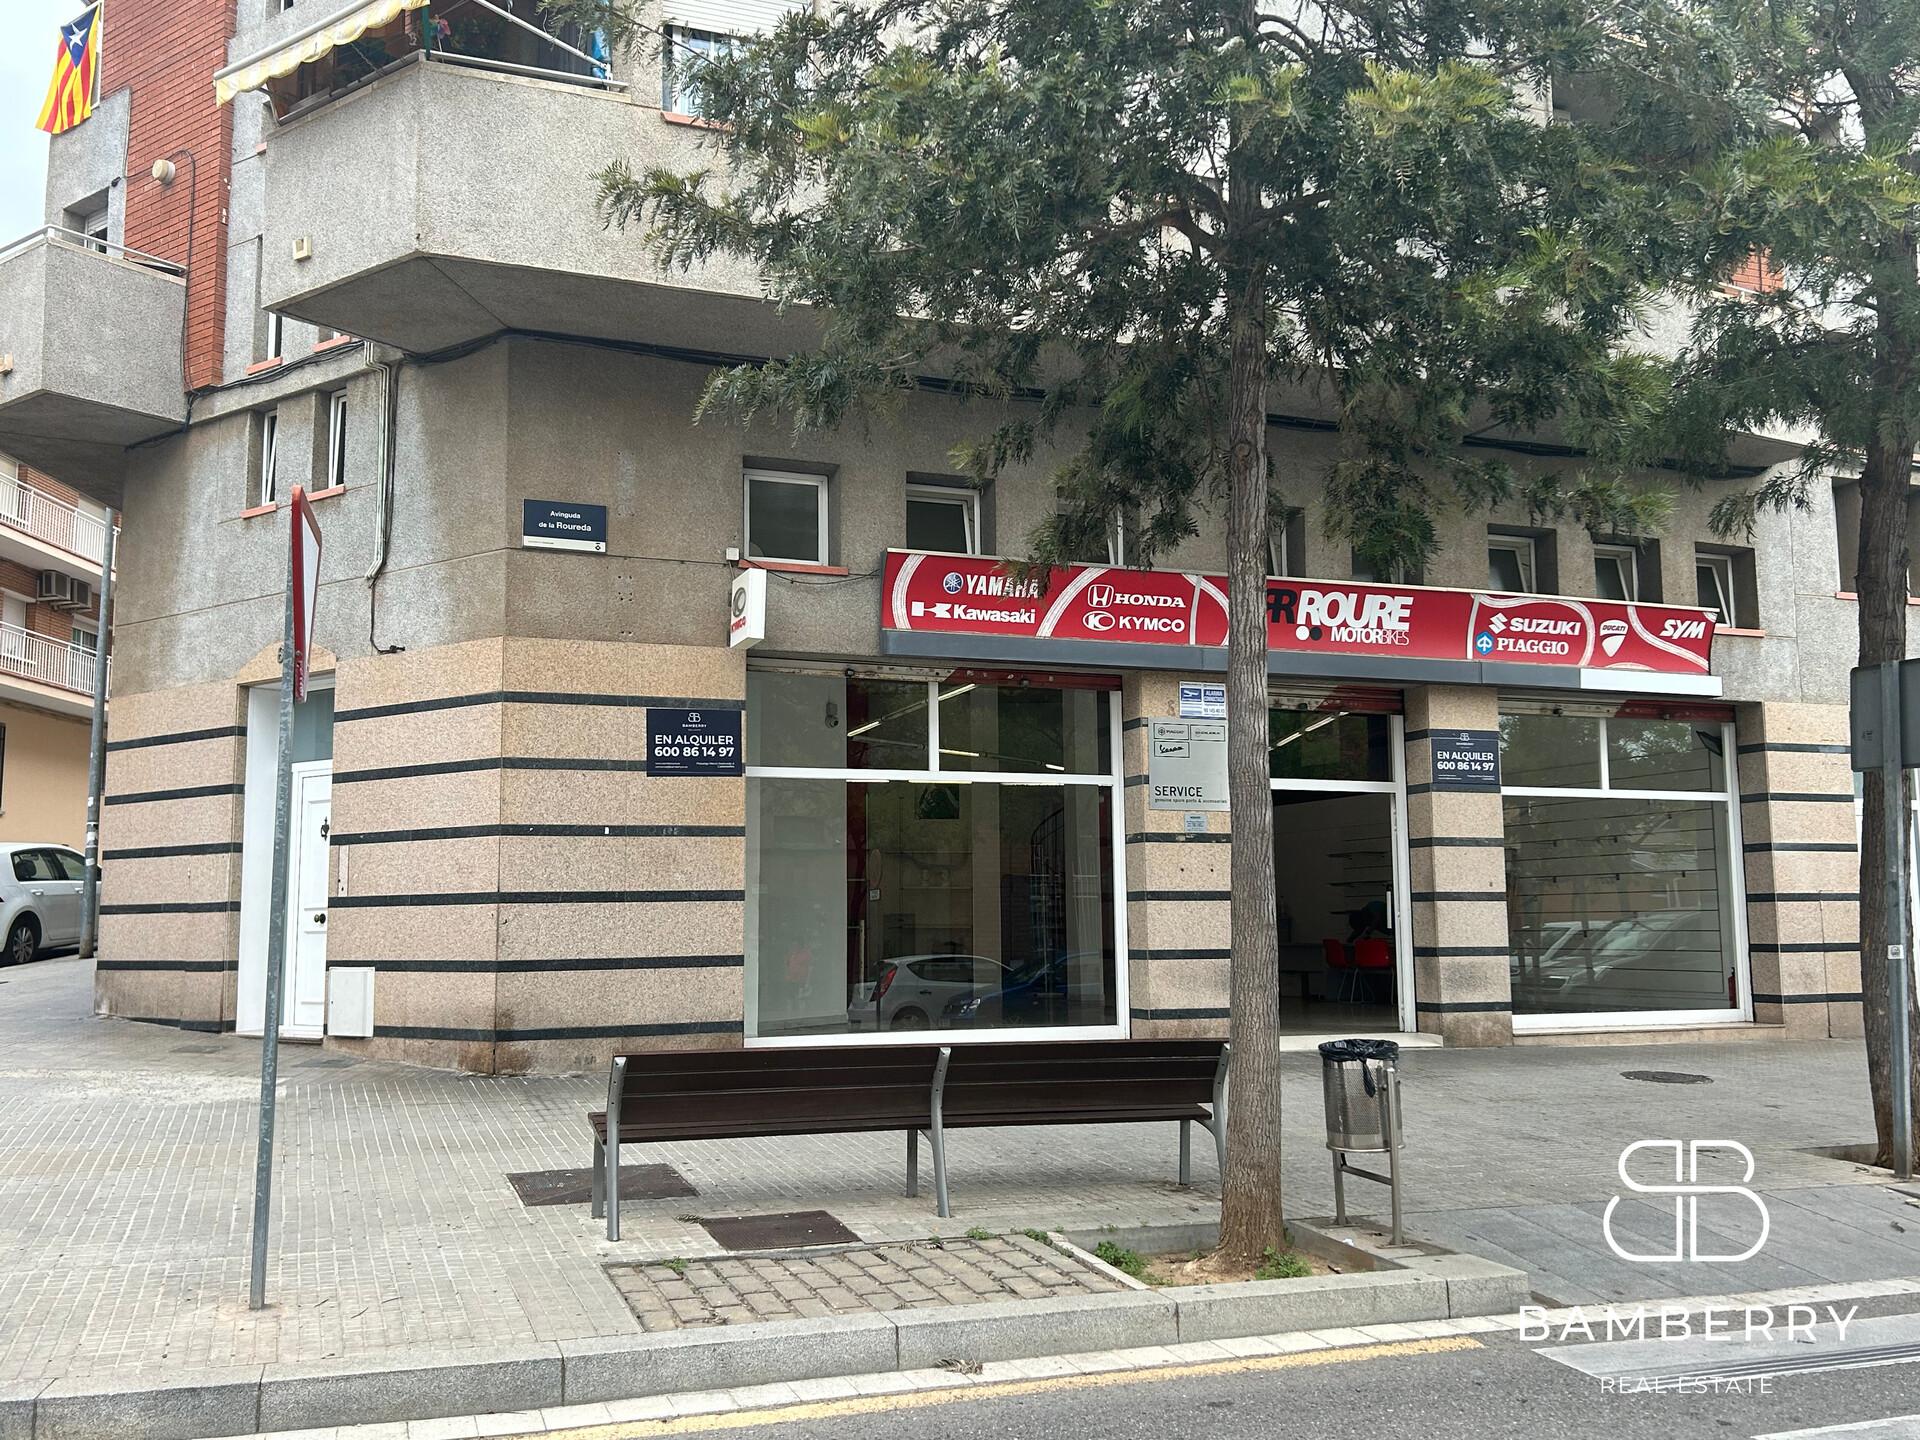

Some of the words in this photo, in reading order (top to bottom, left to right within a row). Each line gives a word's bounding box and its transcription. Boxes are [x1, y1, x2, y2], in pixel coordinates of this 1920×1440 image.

[550, 510, 581, 519] Avinguda
[556, 522, 592, 531] Roureda
[1114, 593, 1186, 609] HONDA
[953, 604, 1036, 625] Kawasaki
[1296, 590, 1414, 630] ROURE
[1118, 617, 1186, 633] KYMCO
[1509, 617, 1582, 636] SUZUKI
[1602, 624, 1627, 632] DUCATI
[1660, 619, 1707, 640] SYM
[1330, 626, 1410, 646] MOTORBIKES
[1496, 637, 1570, 656] PIAGGIO
[655, 735, 672, 745] EN
[675, 735, 734, 746] ALQUILER
[655, 746, 680, 757] 600
[682, 746, 699, 757] 86
[702, 747, 716, 757] 14
[719, 747, 735, 757] 97
[1437, 751, 1449, 759] EN
[1451, 752, 1494, 761] ALQUILER
[1437, 761, 1455, 770] 600
[1457, 762, 1470, 770] 86
[1471, 762, 1481, 770] 14
[1482, 762, 1495, 771] 97
[1154, 785, 1203, 797] SERVICE
